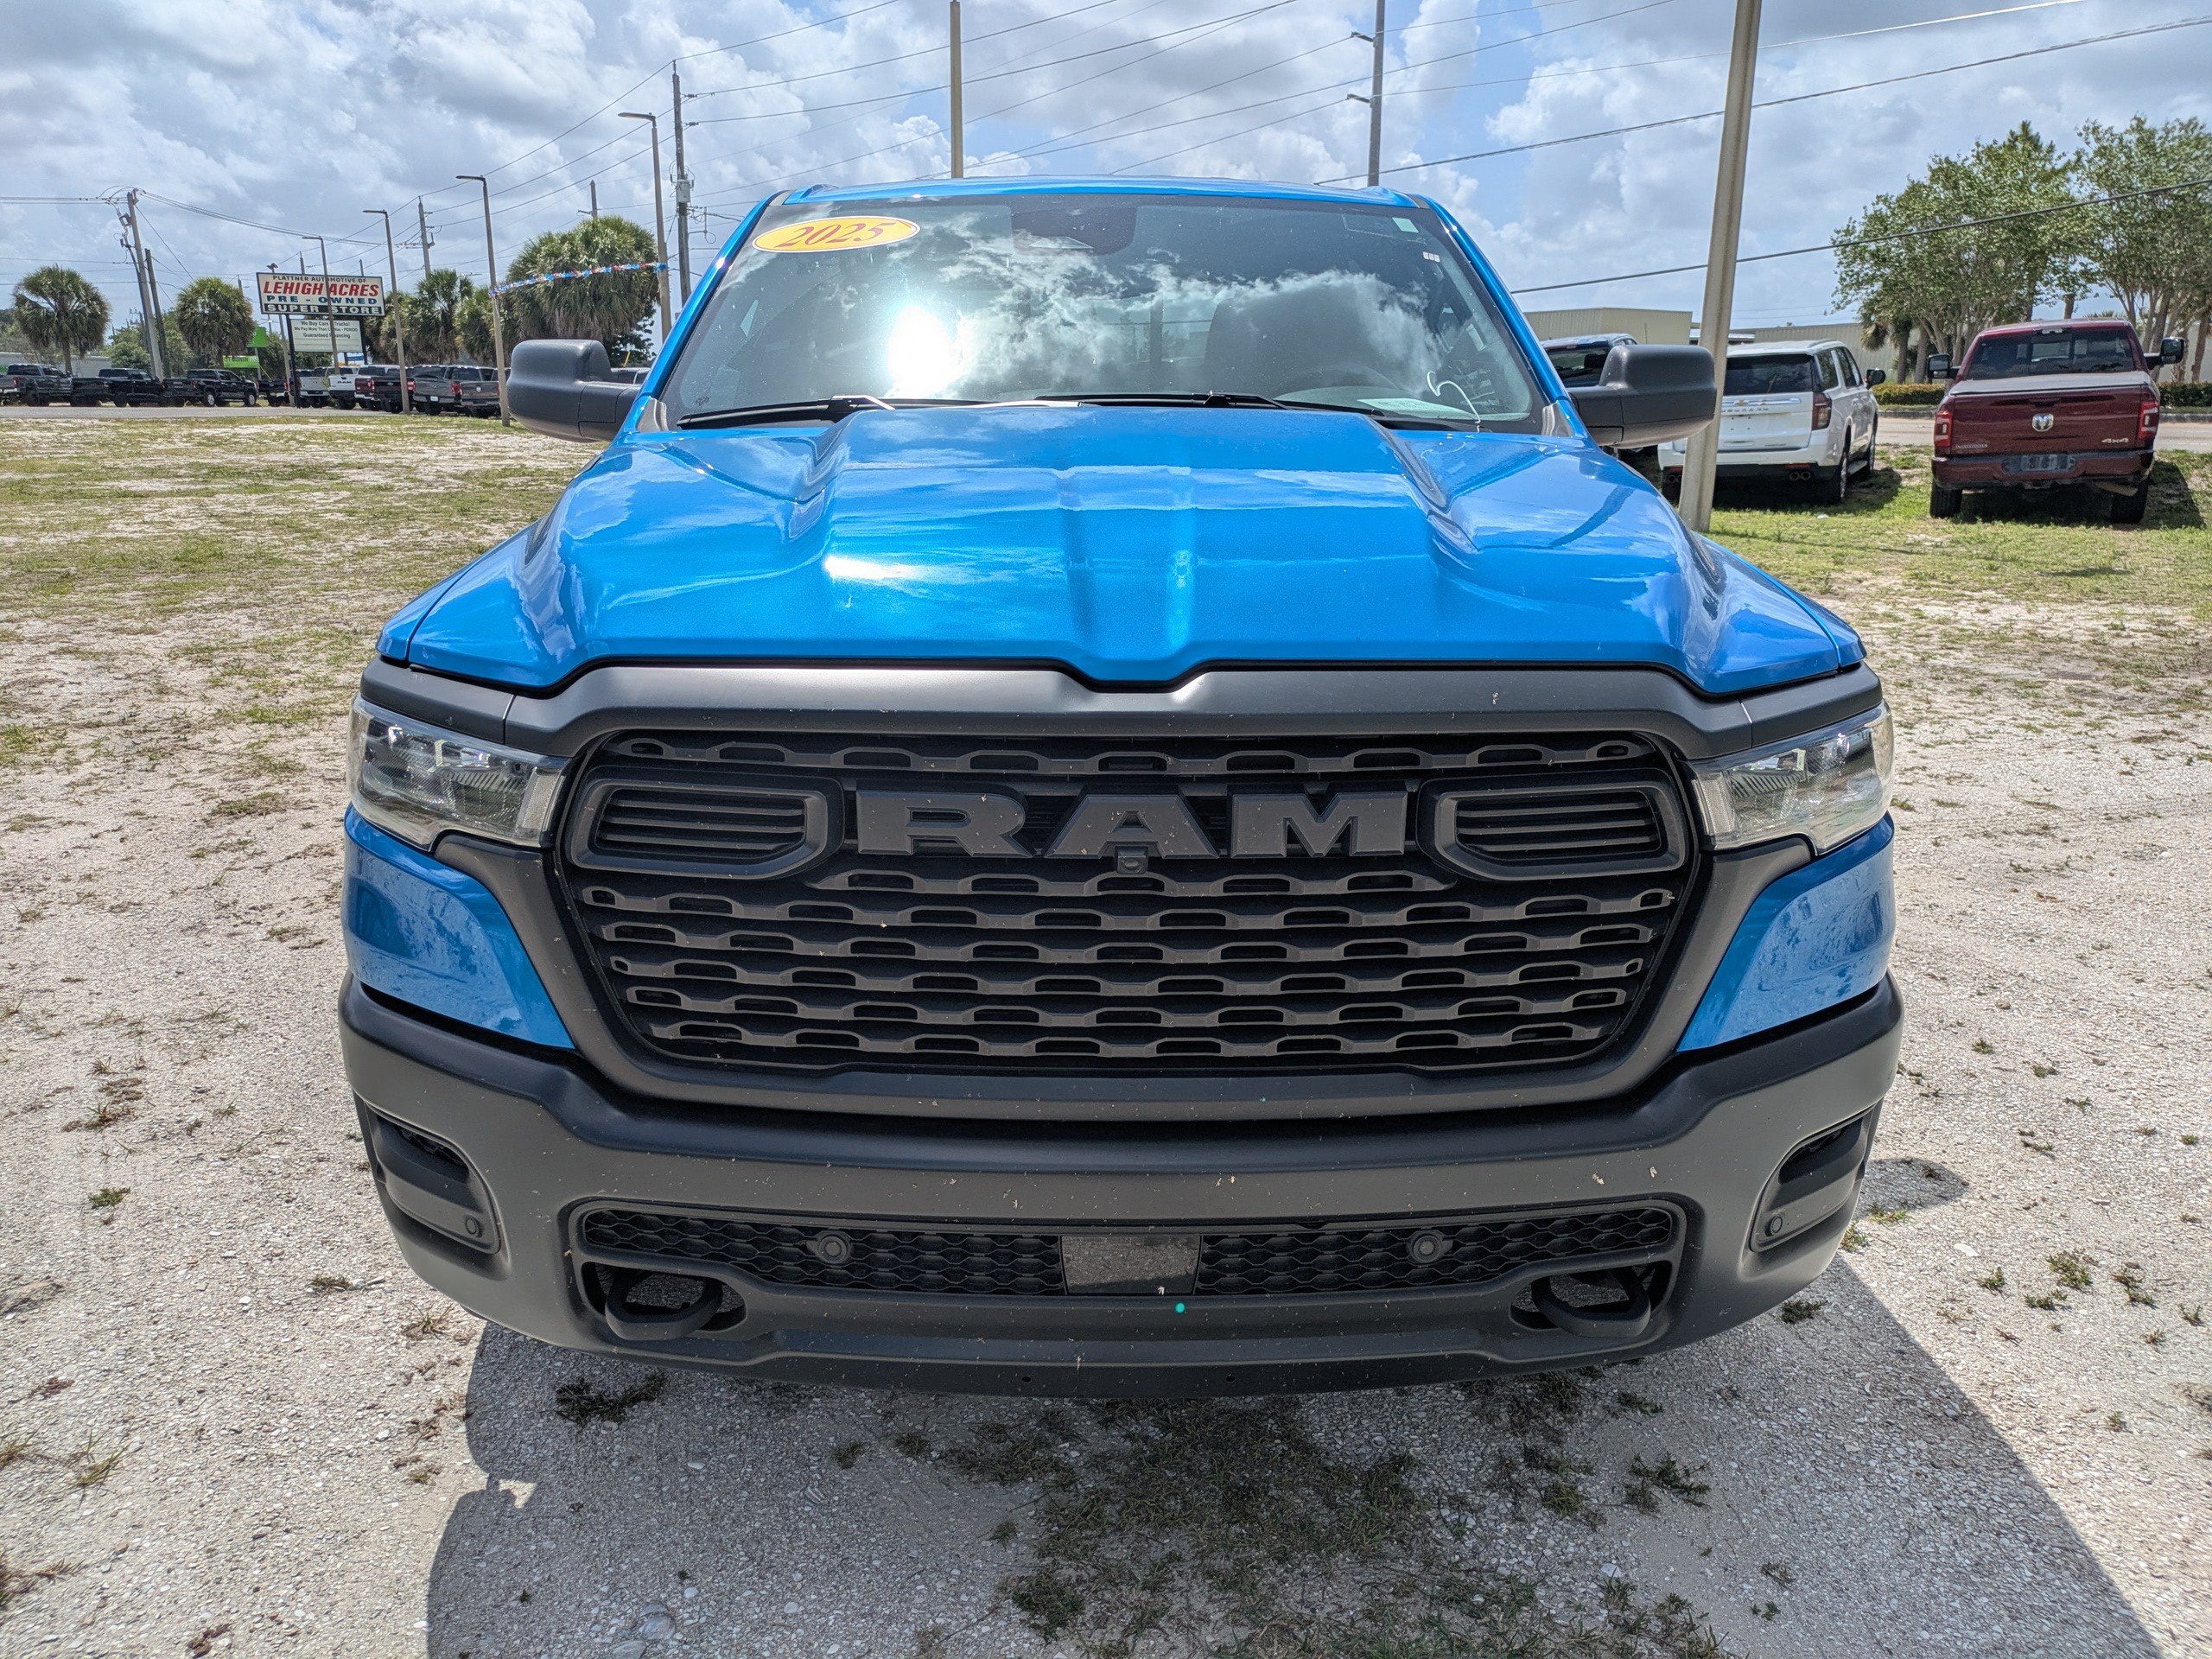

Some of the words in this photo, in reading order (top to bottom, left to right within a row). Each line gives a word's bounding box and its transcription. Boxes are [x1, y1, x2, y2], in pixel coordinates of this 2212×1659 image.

[774, 222, 896, 248] 2025
[264, 282, 323, 295] LEHIGH
[329, 283, 378, 296] ACRES
[267, 304, 320, 313] SUPER
[856, 787, 1408, 859] RAM
